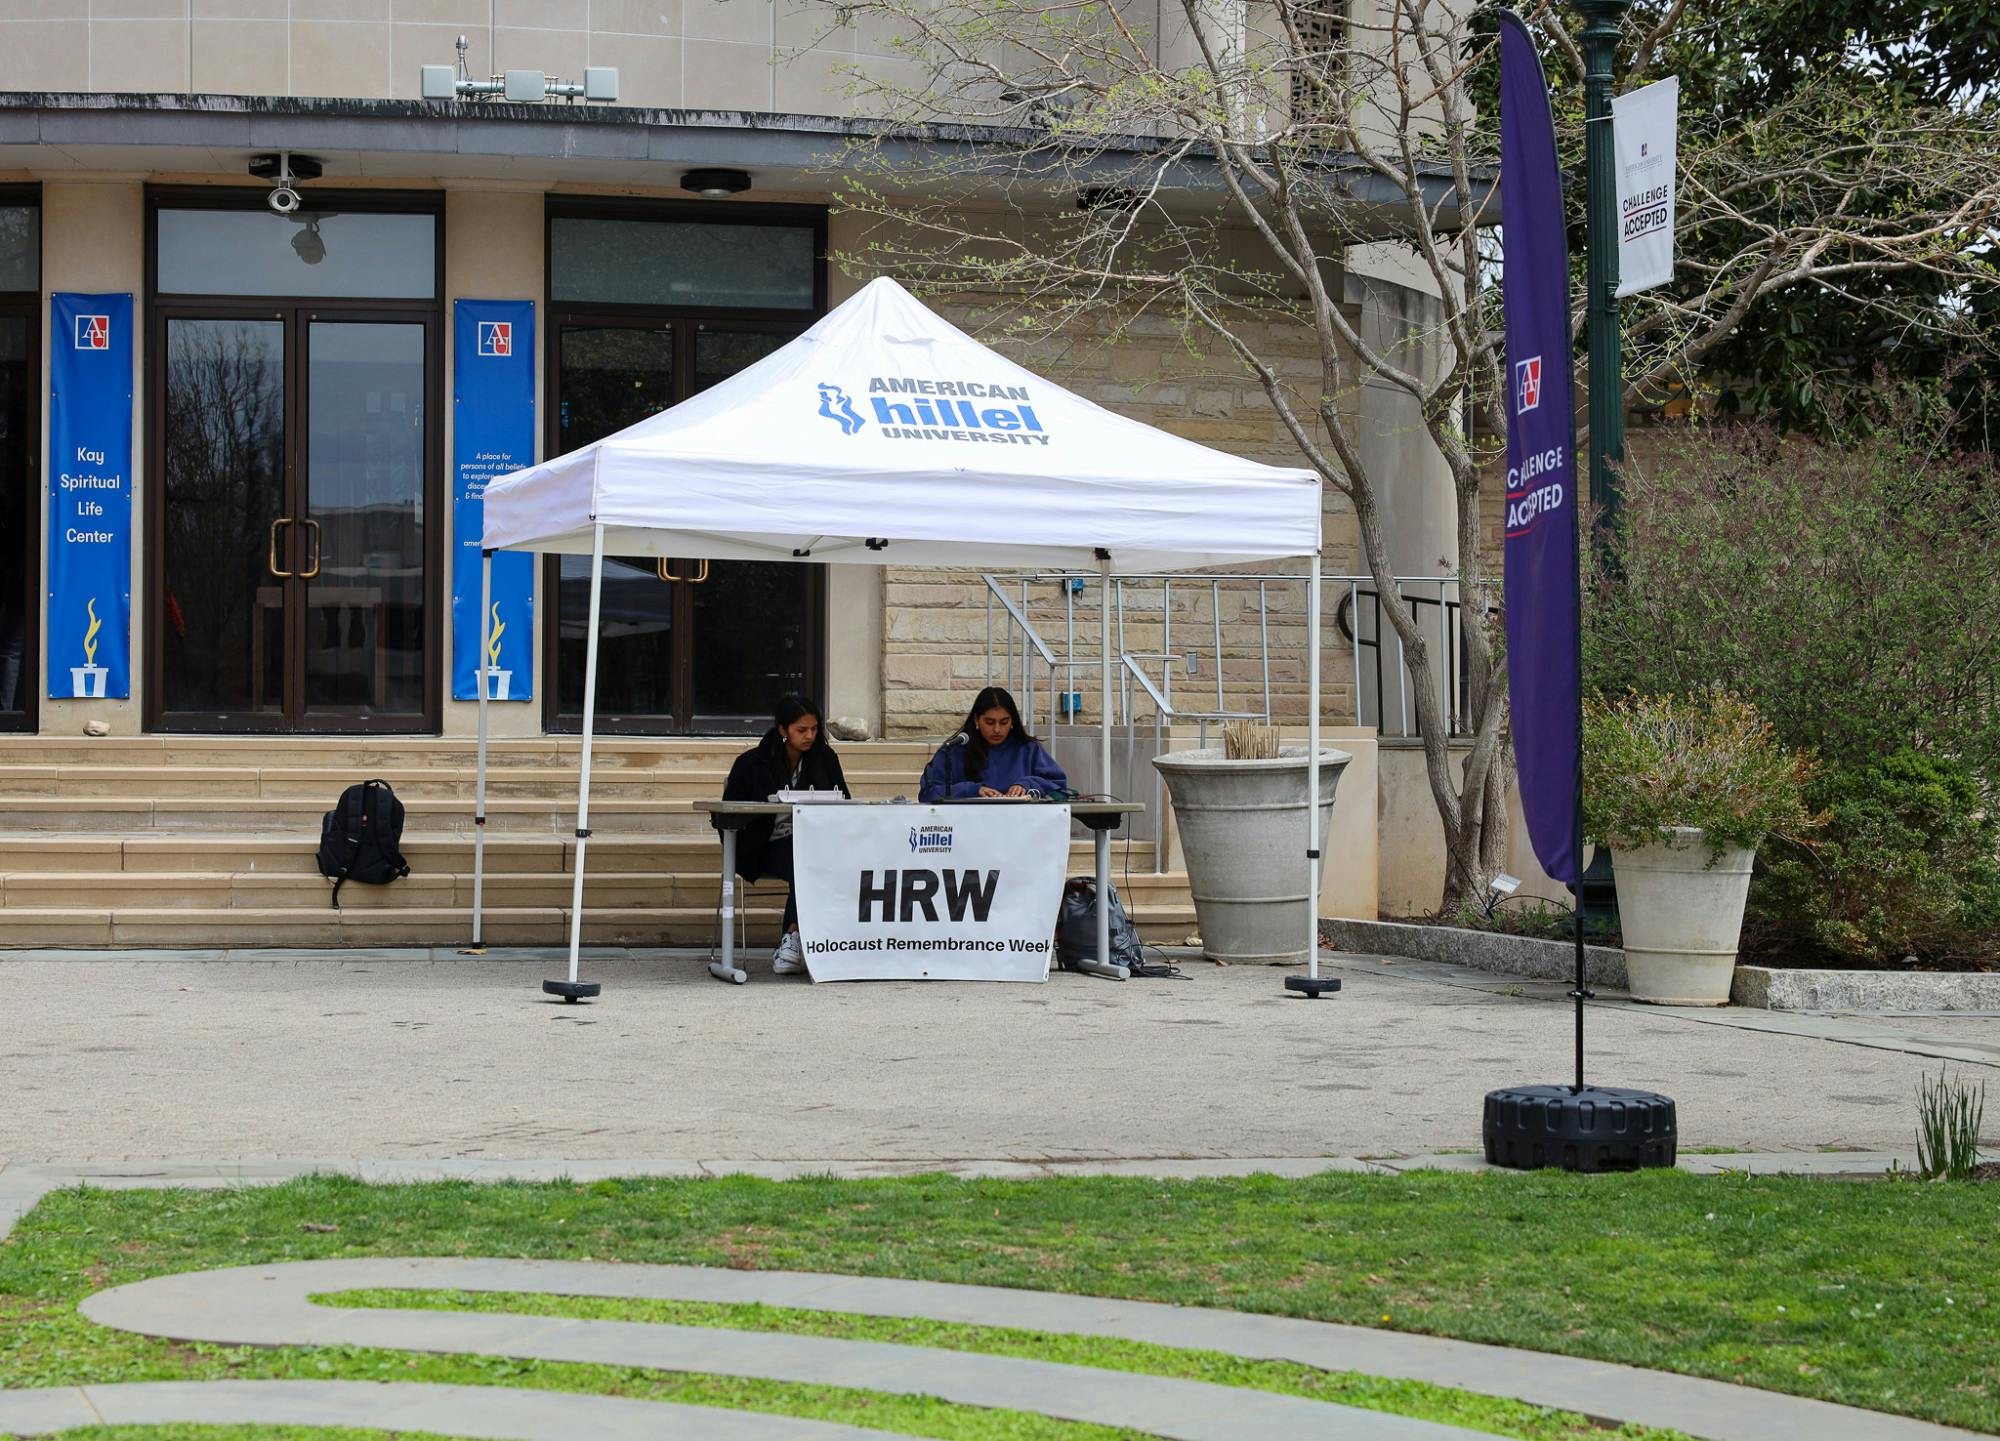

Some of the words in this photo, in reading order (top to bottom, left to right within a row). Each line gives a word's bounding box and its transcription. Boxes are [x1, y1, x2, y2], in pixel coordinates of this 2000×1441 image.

[1623, 184, 1668, 212] CHALLENGE
[1625, 208, 1668, 237] ACCEPTED
[868, 377, 1030, 401] AMERICAN
[870, 397, 1043, 432] hillel
[881, 427, 1049, 446] UNIVERSITY
[77, 447, 105, 465] Kay
[475, 452, 481, 460] A
[481, 452, 500, 462] place
[501, 452, 512, 460] for
[460, 463, 486, 471] persons
[487, 462, 495, 471] of
[495, 462, 505, 471] all
[60, 474, 120, 492] Spiritual
[462, 472, 470, 480] to
[464, 491, 471, 500] &
[77, 501, 104, 516] Life
[66, 528, 113, 543] Center
[920, 833, 952, 846] hillel
[858, 869, 1000, 922] HRW
[806, 938, 882, 954] Holocaust
[886, 937, 1005, 952] Remembrance
